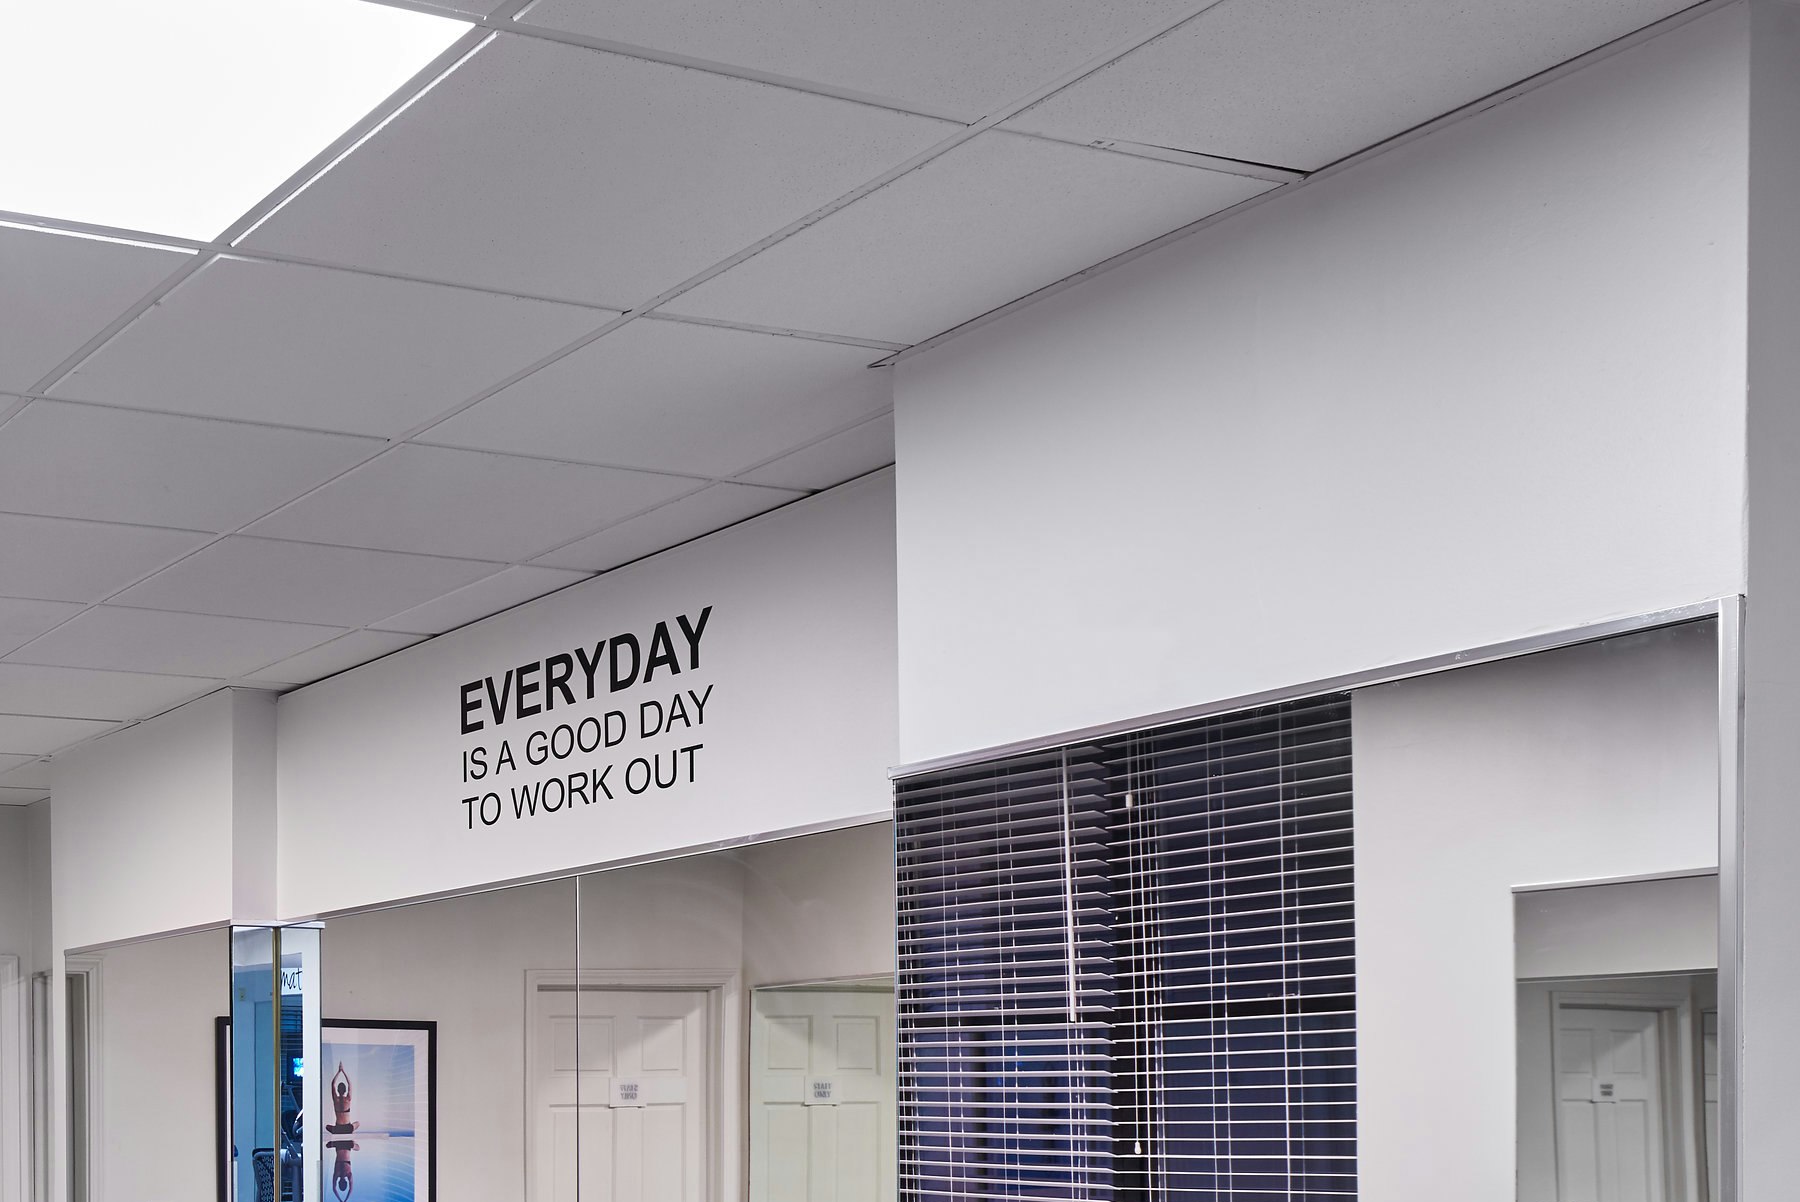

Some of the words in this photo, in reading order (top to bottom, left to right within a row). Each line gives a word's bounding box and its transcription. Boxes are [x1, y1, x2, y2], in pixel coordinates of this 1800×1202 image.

[460, 605, 713, 736] EVERYDAY
[462, 747, 488, 783] IS
[495, 740, 517, 776] A
[526, 710, 627, 766] GOOD
[639, 684, 714, 739] DAY
[462, 792, 502, 829] TO
[511, 764, 614, 820] WORK
[625, 743, 704, 795] OUT
